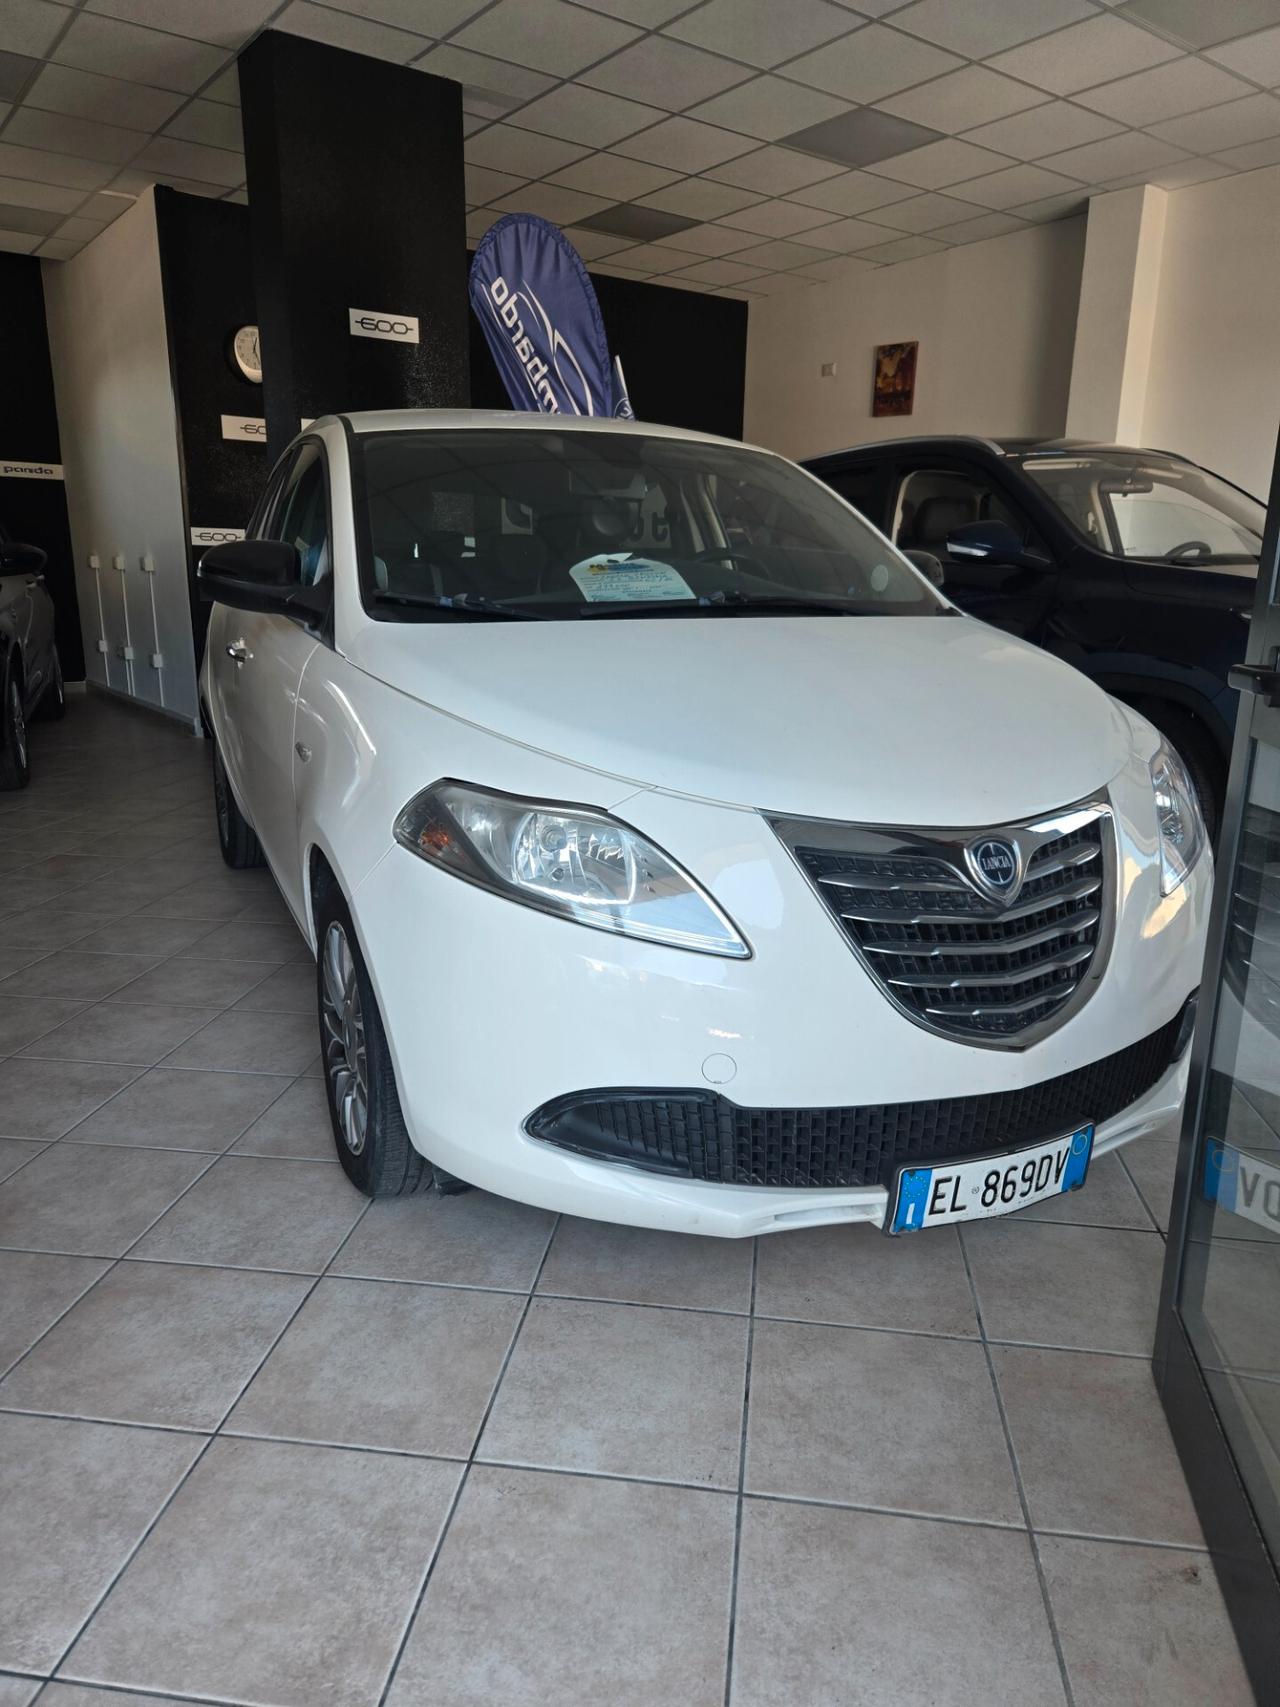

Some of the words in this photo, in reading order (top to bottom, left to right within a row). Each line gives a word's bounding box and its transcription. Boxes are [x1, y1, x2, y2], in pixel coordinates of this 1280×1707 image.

[3, 465, 54, 475] panda
[981, 855, 1011, 870] LANCIA
[928, 1175, 967, 1216] EL
[980, 1147, 1070, 1207] 869DV
